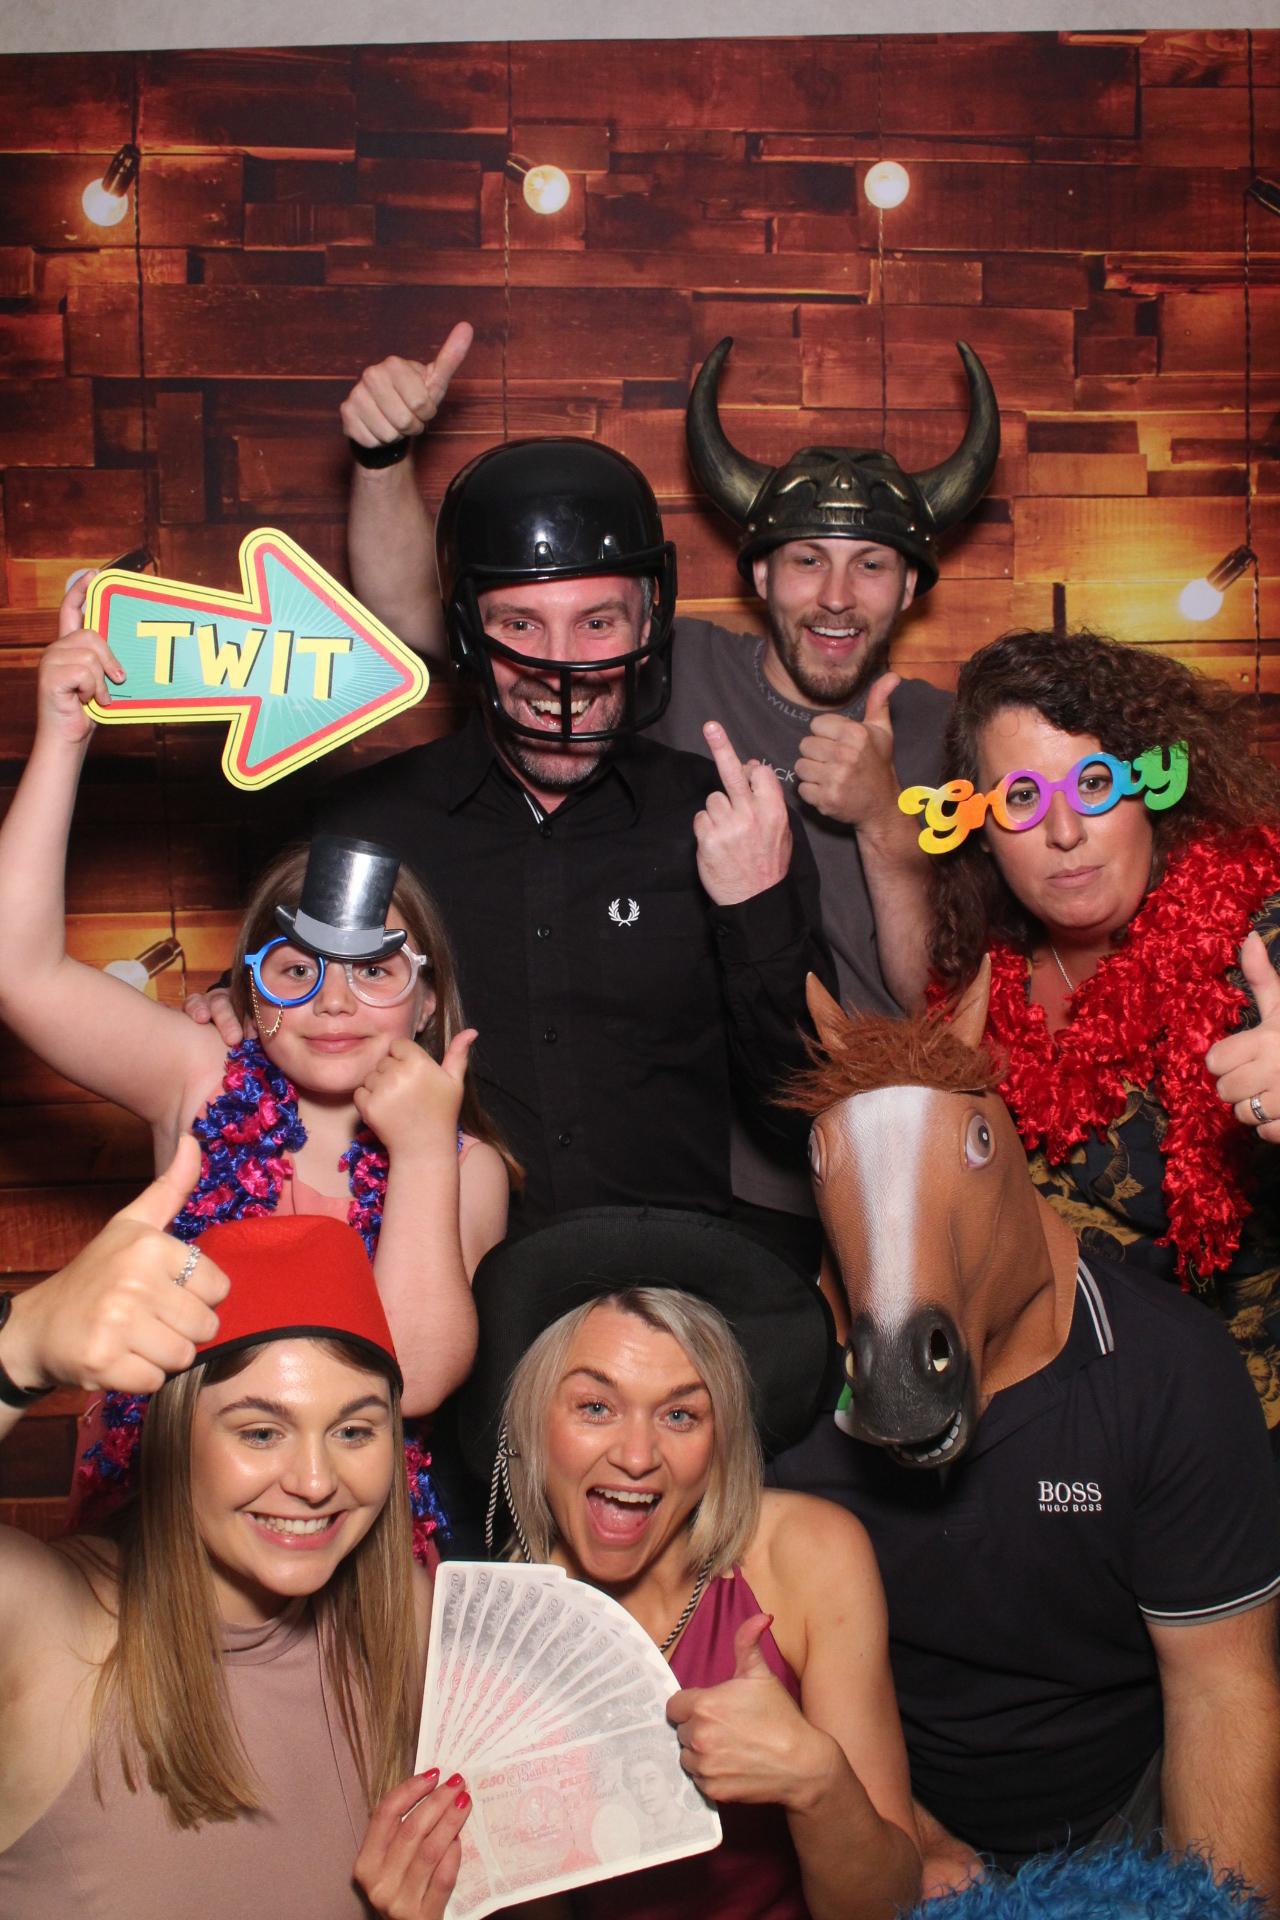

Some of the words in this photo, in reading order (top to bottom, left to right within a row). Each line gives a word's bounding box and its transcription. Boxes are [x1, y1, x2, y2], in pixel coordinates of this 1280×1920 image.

[136, 620, 353, 701] TWIT
[767, 691, 811, 722] WILLS
[1037, 1480, 1102, 1503] BOSS
[1039, 1503, 1069, 1512] HUGO
[1072, 1503, 1102, 1512] BOSS
[451, 1573, 460, 1589] 50
[498, 1580, 508, 1593] 50
[525, 1586, 537, 1600] 50
